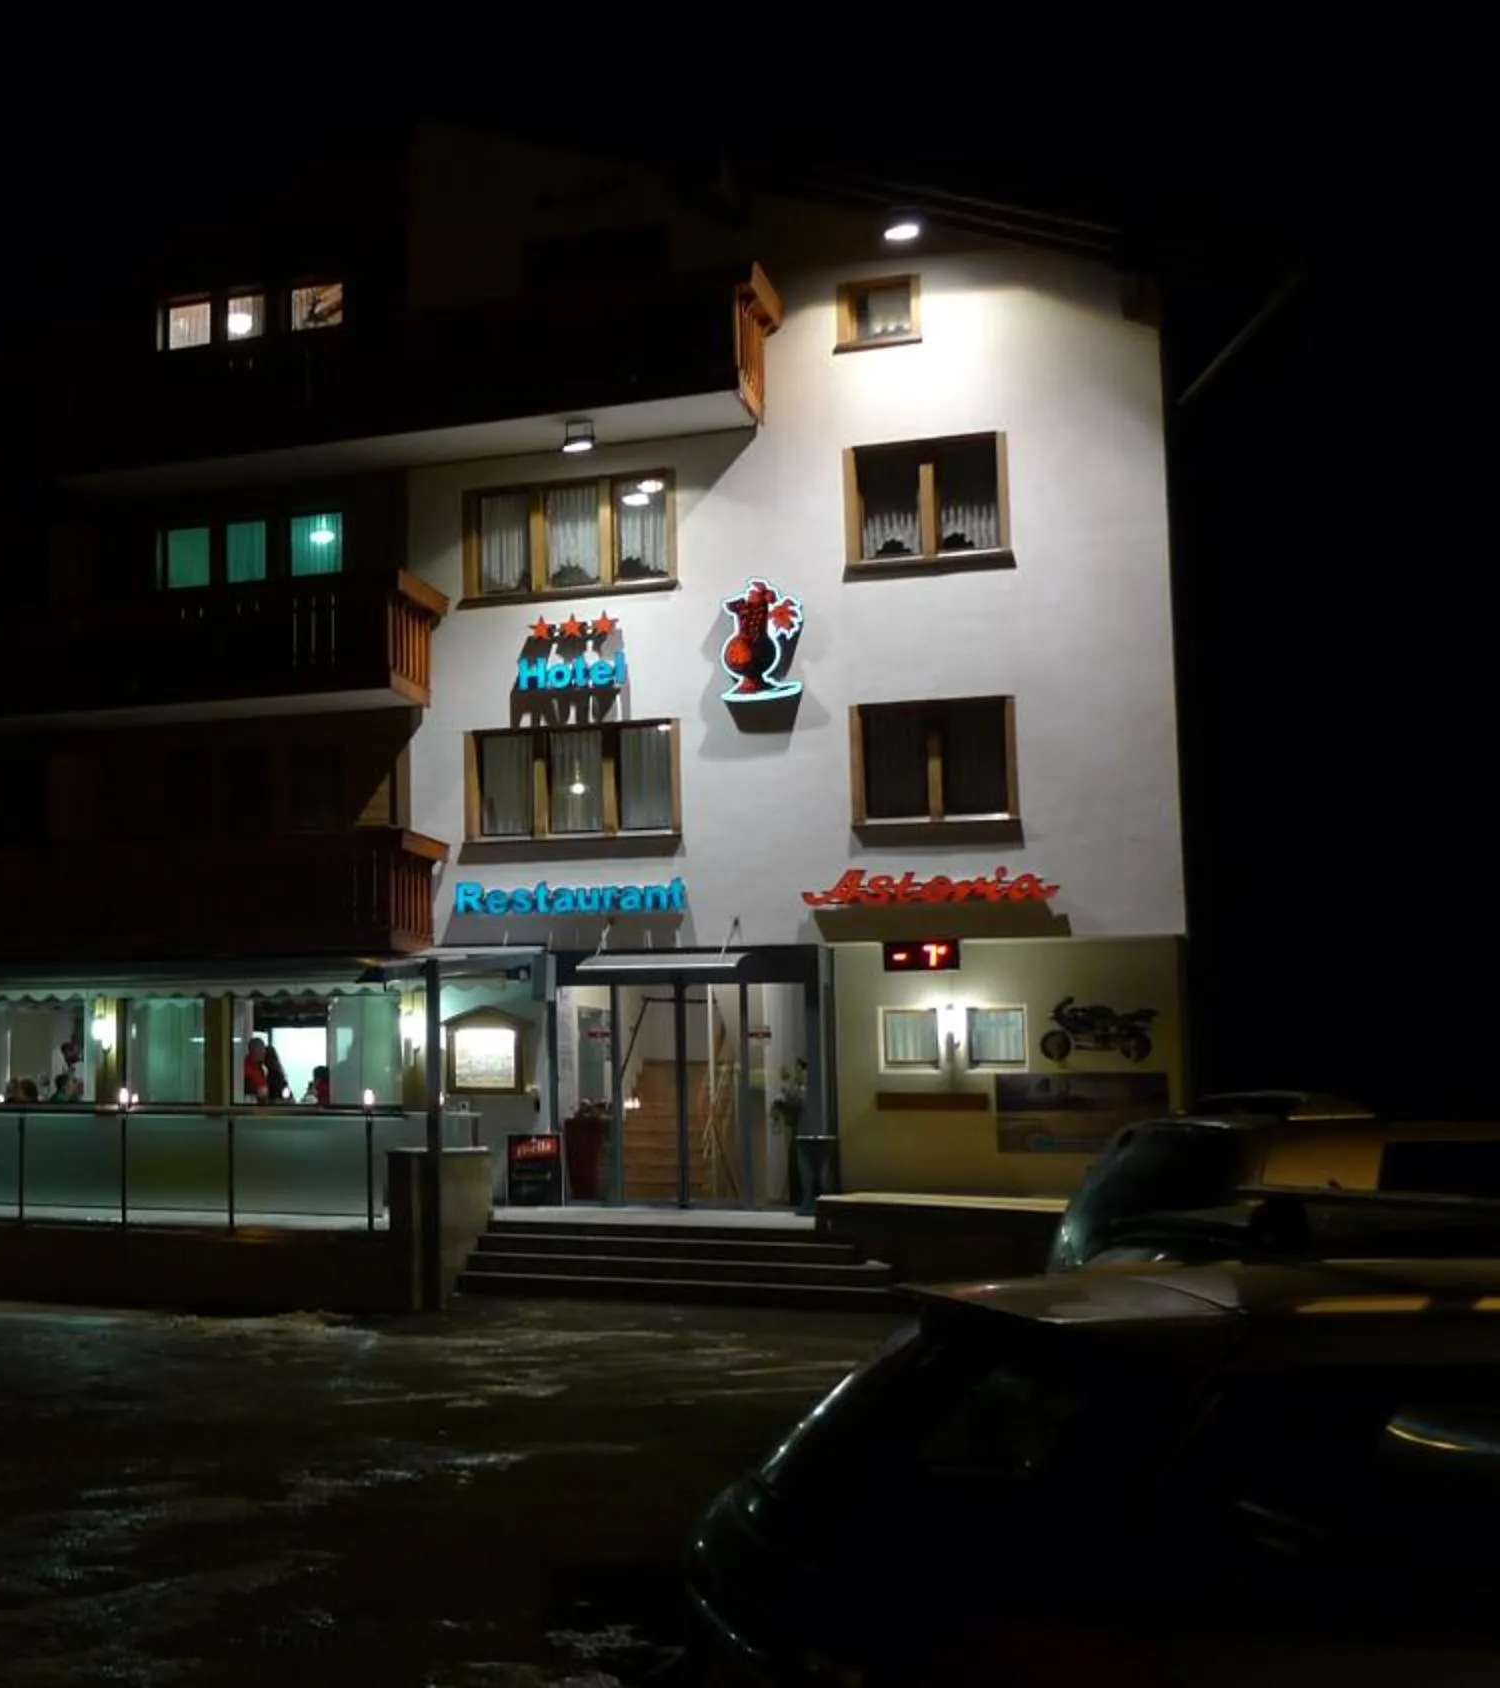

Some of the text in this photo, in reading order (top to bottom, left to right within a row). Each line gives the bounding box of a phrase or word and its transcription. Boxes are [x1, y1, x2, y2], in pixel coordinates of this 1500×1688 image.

[517, 650, 626, 692] Hotel
[454, 876, 687, 916] Restaurant
[801, 866, 1060, 907] Astoria
